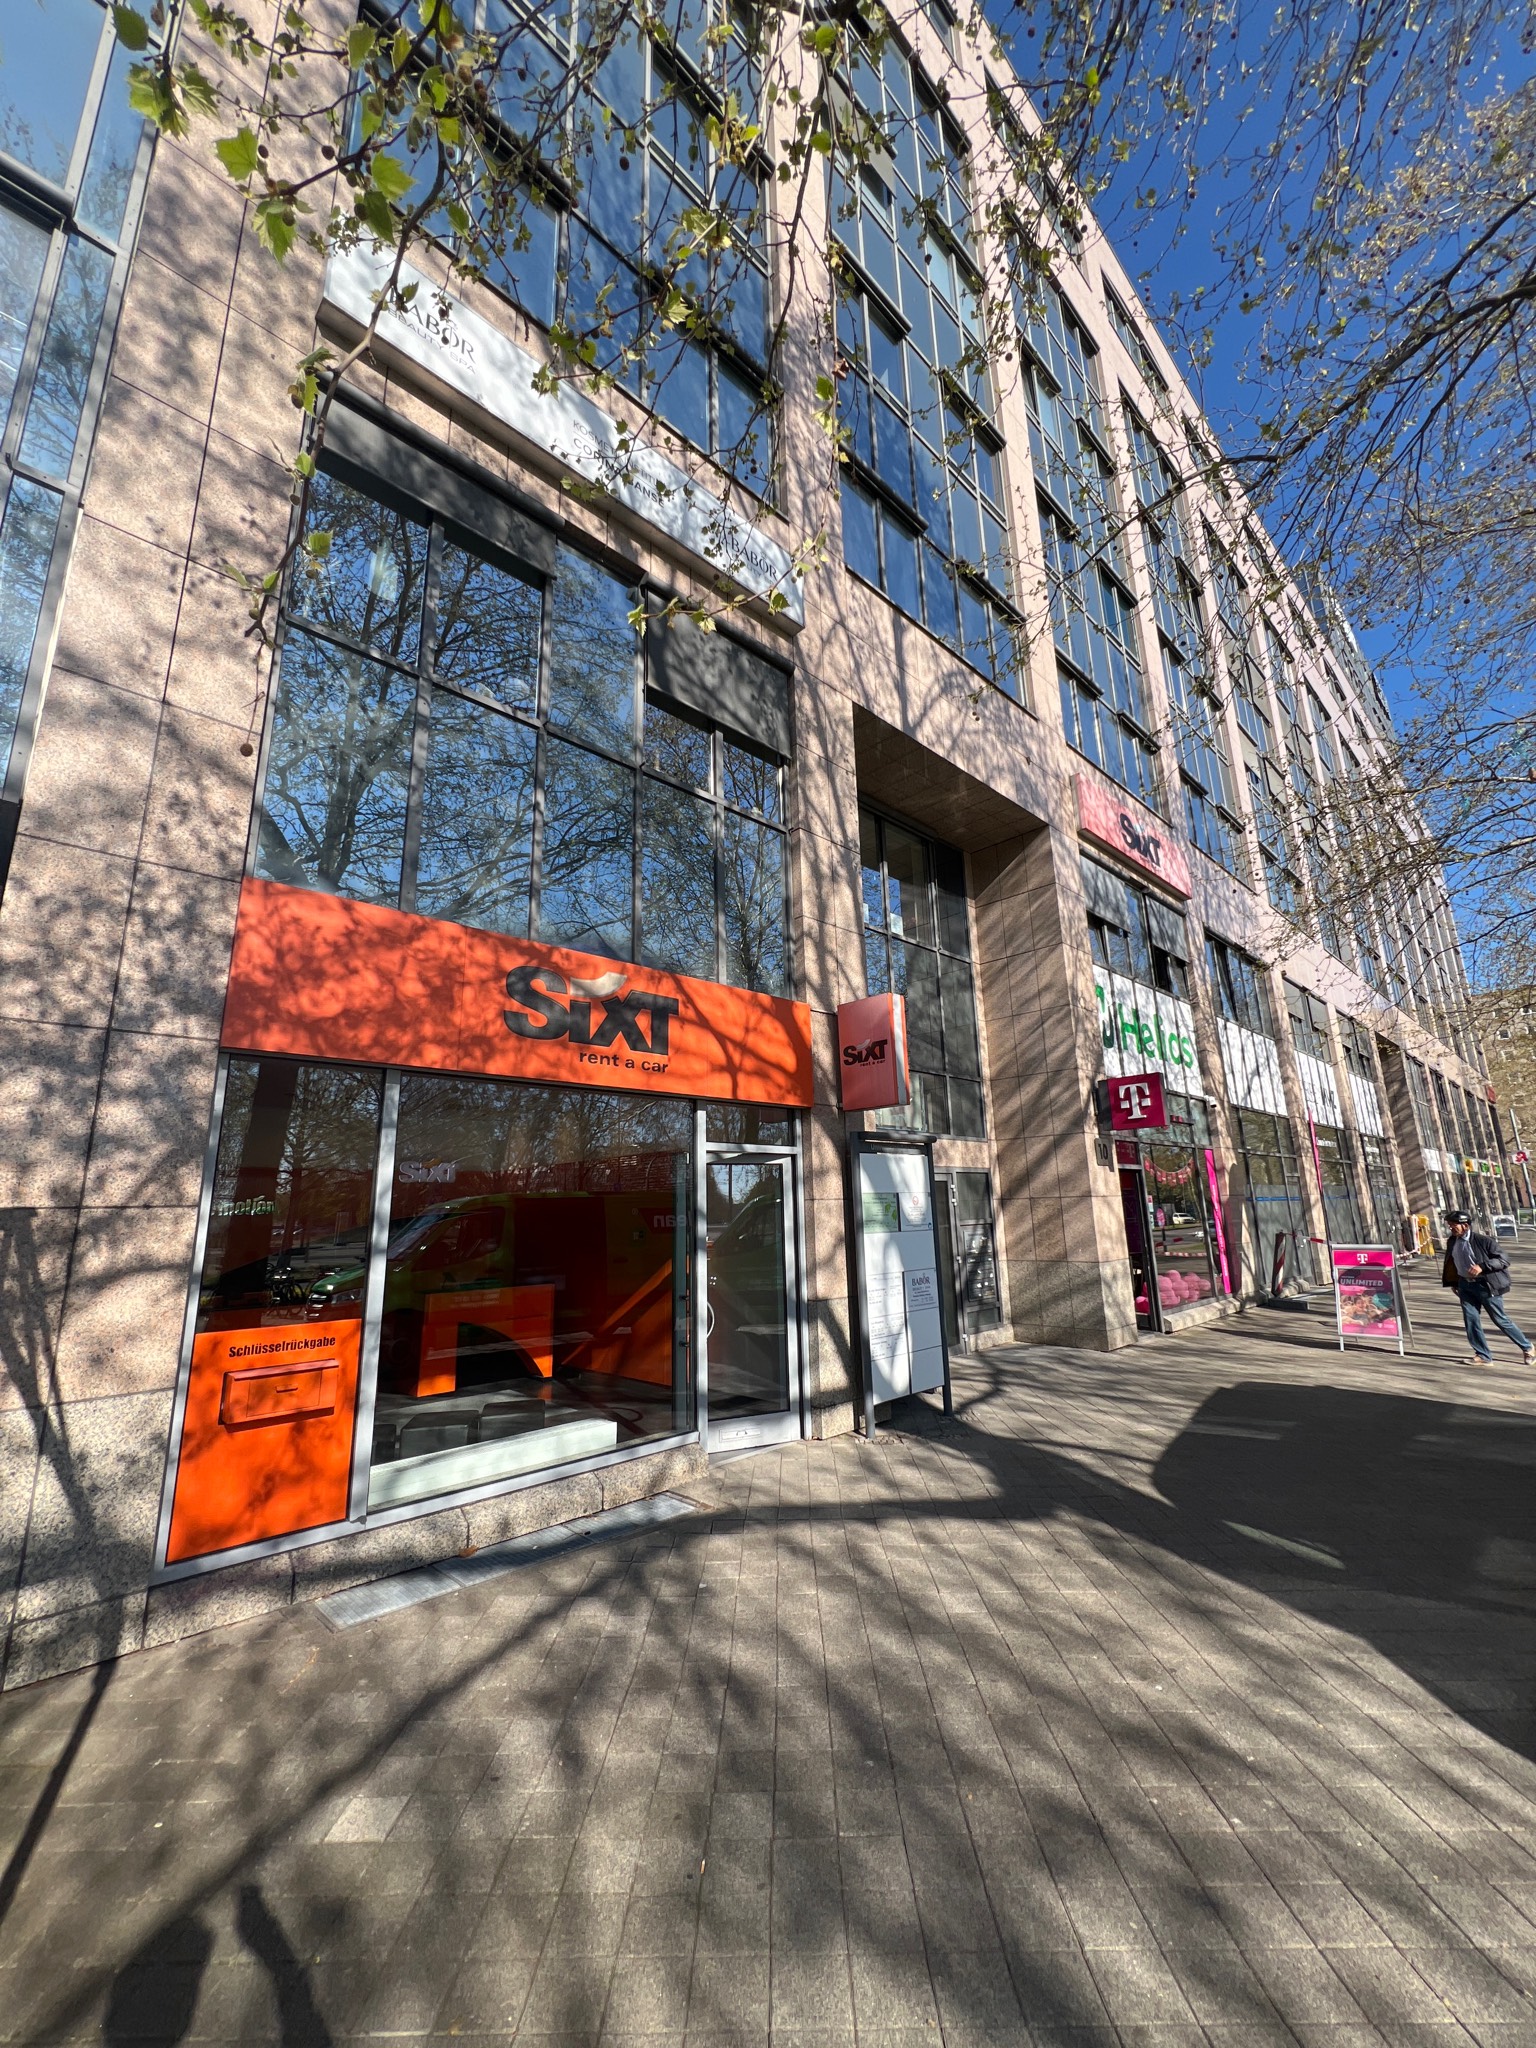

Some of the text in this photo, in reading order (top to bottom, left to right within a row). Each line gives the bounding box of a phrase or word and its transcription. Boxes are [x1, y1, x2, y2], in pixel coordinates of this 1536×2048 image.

[450, 351, 476, 375] SPA
[1117, 1003, 1194, 1069] Helios
[579, 1051, 669, 1073] rent a car
[1118, 1082, 1151, 1119] T
[1098, 1143, 1109, 1160] 10
[1357, 1253, 1368, 1264] T
[911, 1275, 930, 1286] BABOR
[1340, 1278, 1384, 1287] UNLIMITED
[228, 1336, 336, 1358] Schlüsselrückgabe
